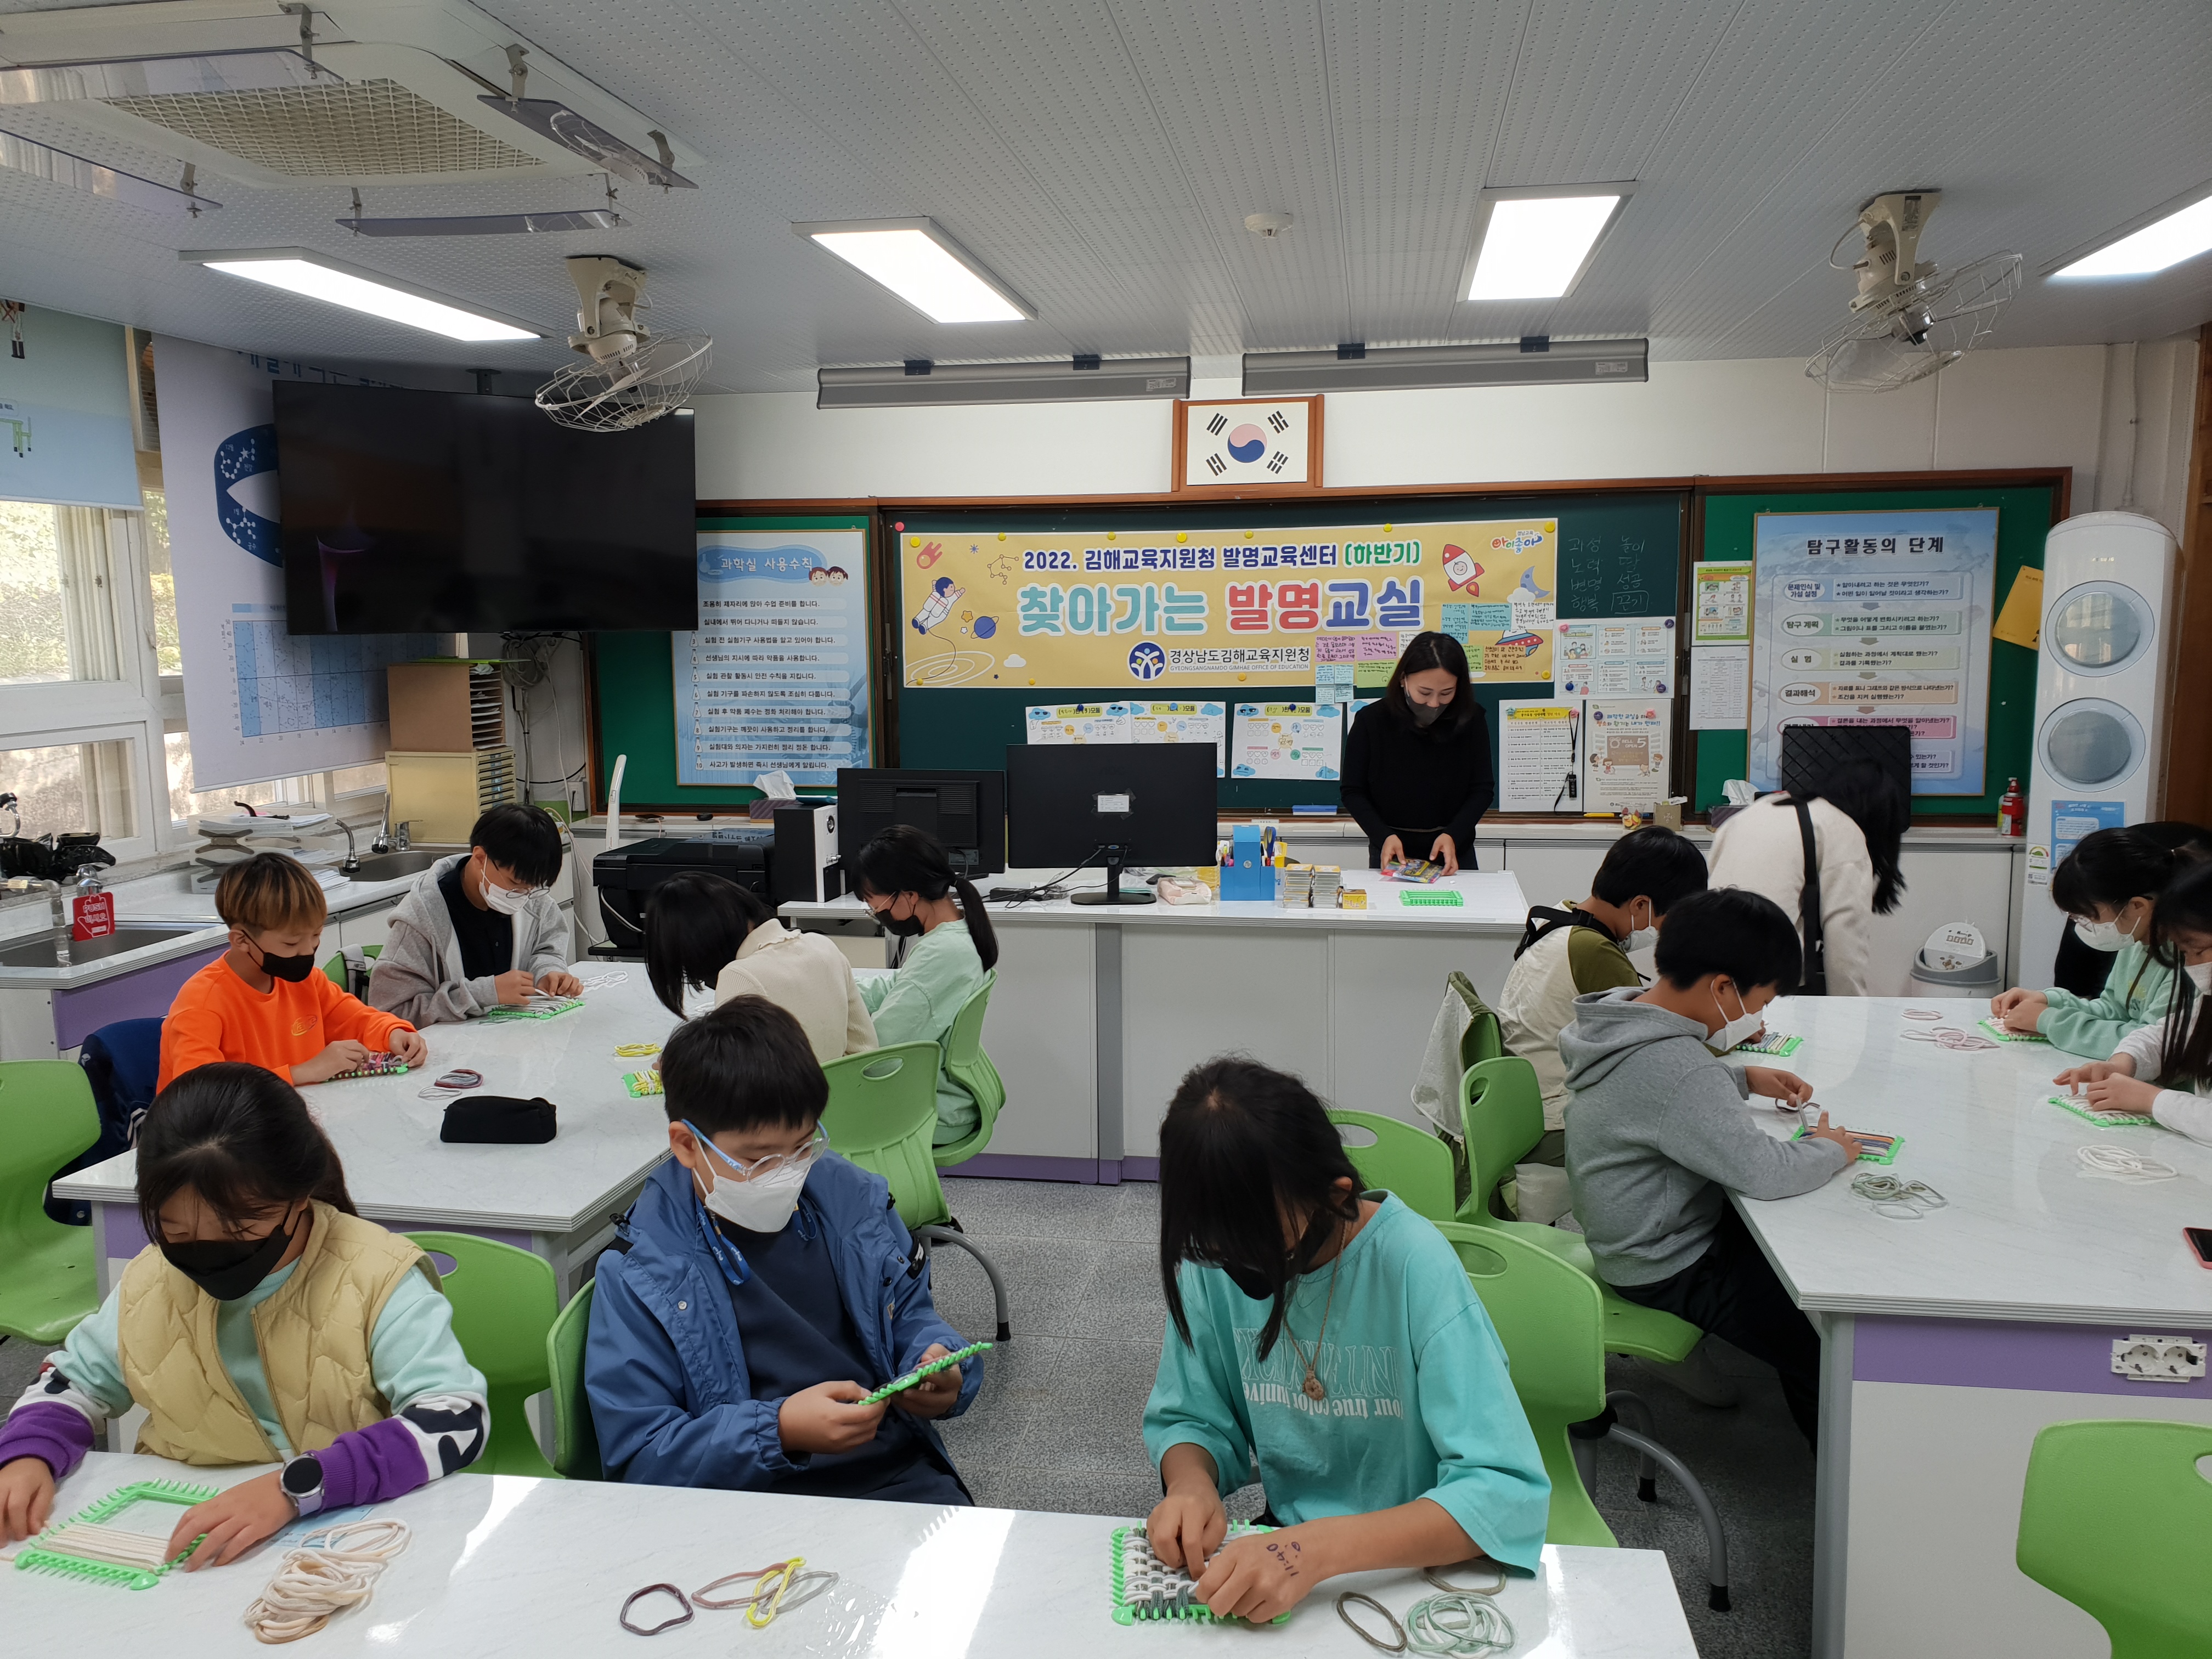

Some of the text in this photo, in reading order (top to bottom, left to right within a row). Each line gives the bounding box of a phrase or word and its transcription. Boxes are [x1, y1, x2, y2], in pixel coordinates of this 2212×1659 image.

[1492, 535, 1543, 554] 아이좋아
[1807, 537, 1944, 555] 탐구활동의 단계
[1025, 541, 1420, 570] 2022. 김해교육지원청 발명교육센터 (하반기)
[721, 557, 812, 572] 과학실 사용수칙
[1572, 558, 1600, 575] 노력
[1617, 573, 1643, 590] 성공
[1020, 586, 1205, 632] 찾아가는
[1229, 579, 1420, 630] 발명교실
[1571, 594, 1642, 612] 행복 끈기
[1170, 648, 1310, 664] 경상남도김해교육지원청
[1637, 738, 1646, 748] 5
[83, 902, 105, 913] PUSH
[1332, 1398, 1368, 1419] true
